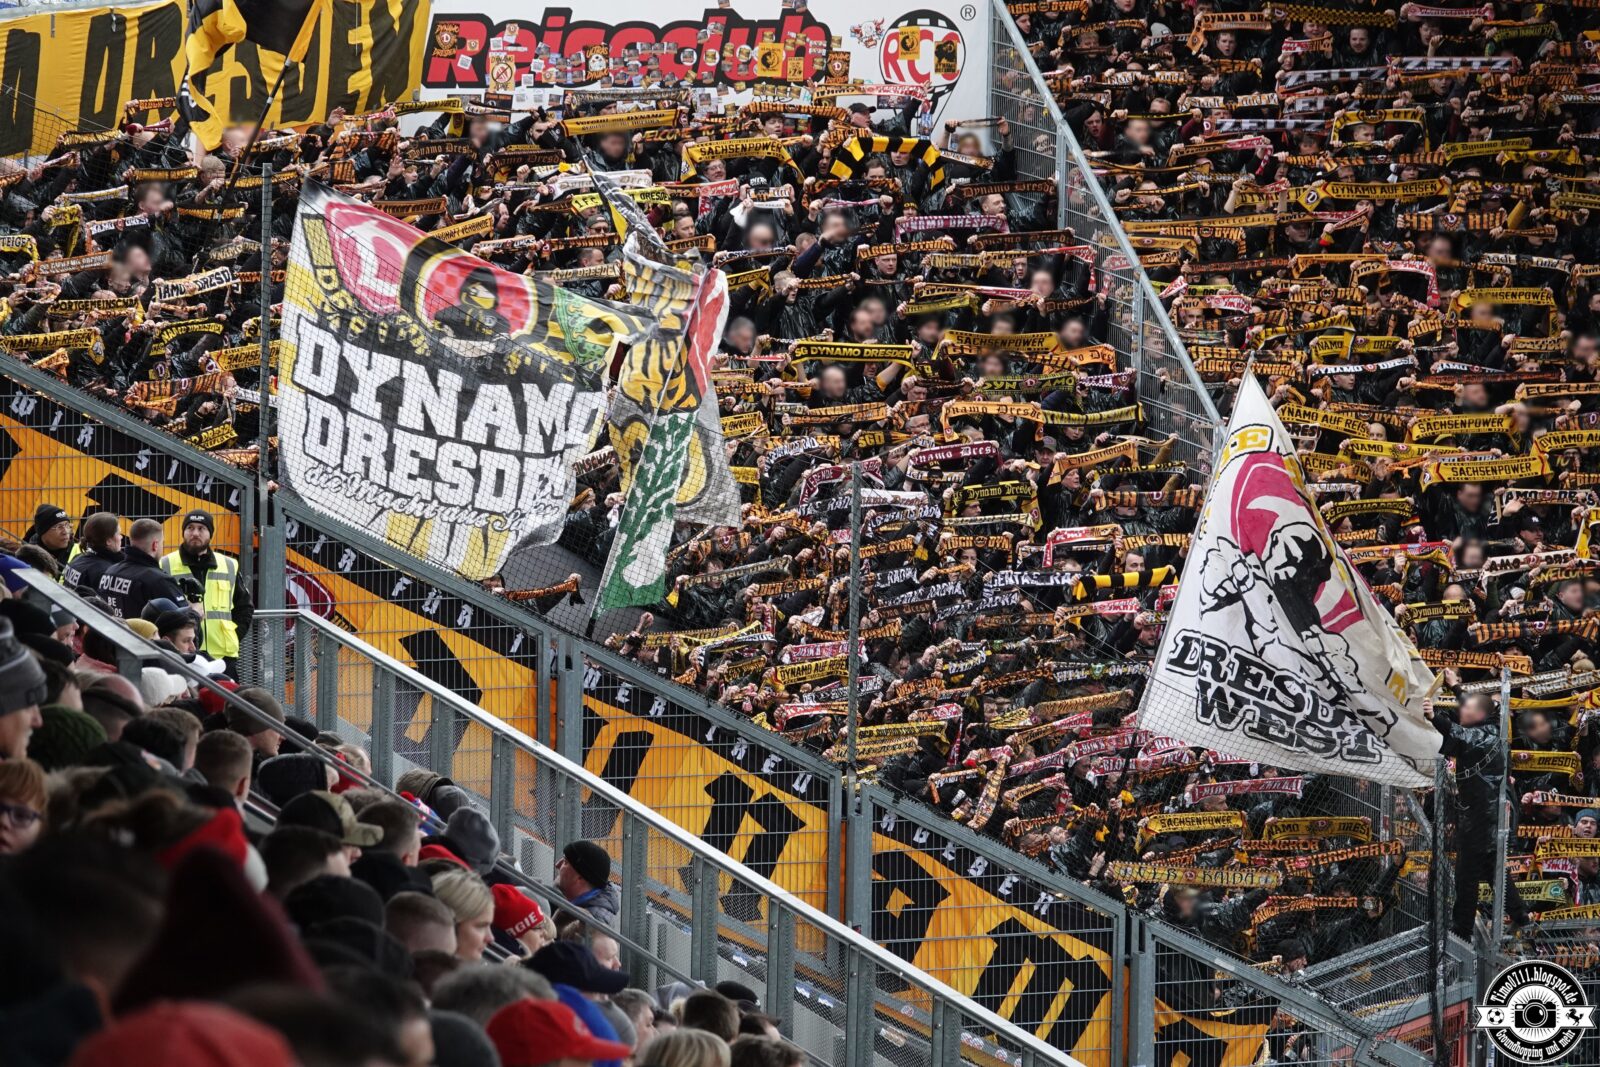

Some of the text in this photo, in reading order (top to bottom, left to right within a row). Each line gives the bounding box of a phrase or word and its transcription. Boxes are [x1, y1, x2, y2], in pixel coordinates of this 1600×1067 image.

[1204, 13, 1245, 23] DYNAMO
[421, 7, 833, 89] Reiseclub
[700, 142, 783, 156] SACHSENPOWER
[1015, 181, 1057, 194] Dresde
[1331, 183, 1437, 196] DYNAMO AUF REISEN
[956, 334, 1046, 349] SACHSENPOWER
[795, 345, 912, 359] SG DYNAMO DRESDEN
[293, 314, 600, 456] DYNAMO
[1286, 424, 1318, 437] DRES
[1321, 413, 1344, 427] AUF
[1345, 418, 1370, 434] REIS
[1418, 417, 1504, 433] SACHSENPOWER
[858, 431, 884, 448] SGD
[1539, 433, 1600, 448] DYNAMO AU
[1350, 442, 1384, 453] NAMO
[1451, 462, 1532, 477] SACHSENPOWER
[1336, 503, 1378, 514] DYNAMO
[1350, 550, 1376, 561] AMO
[1490, 557, 1521, 573] AMO
[99, 574, 132, 596] POLIZEI
[107, 597, 117, 607] BE
[780, 664, 813, 679] DYNAMO
[1196, 678, 1389, 765] WEST
[1537, 756, 1578, 769] DRESDE
[1159, 815, 1233, 829] SACHSENPOWER
[1268, 823, 1300, 838] NAMO
